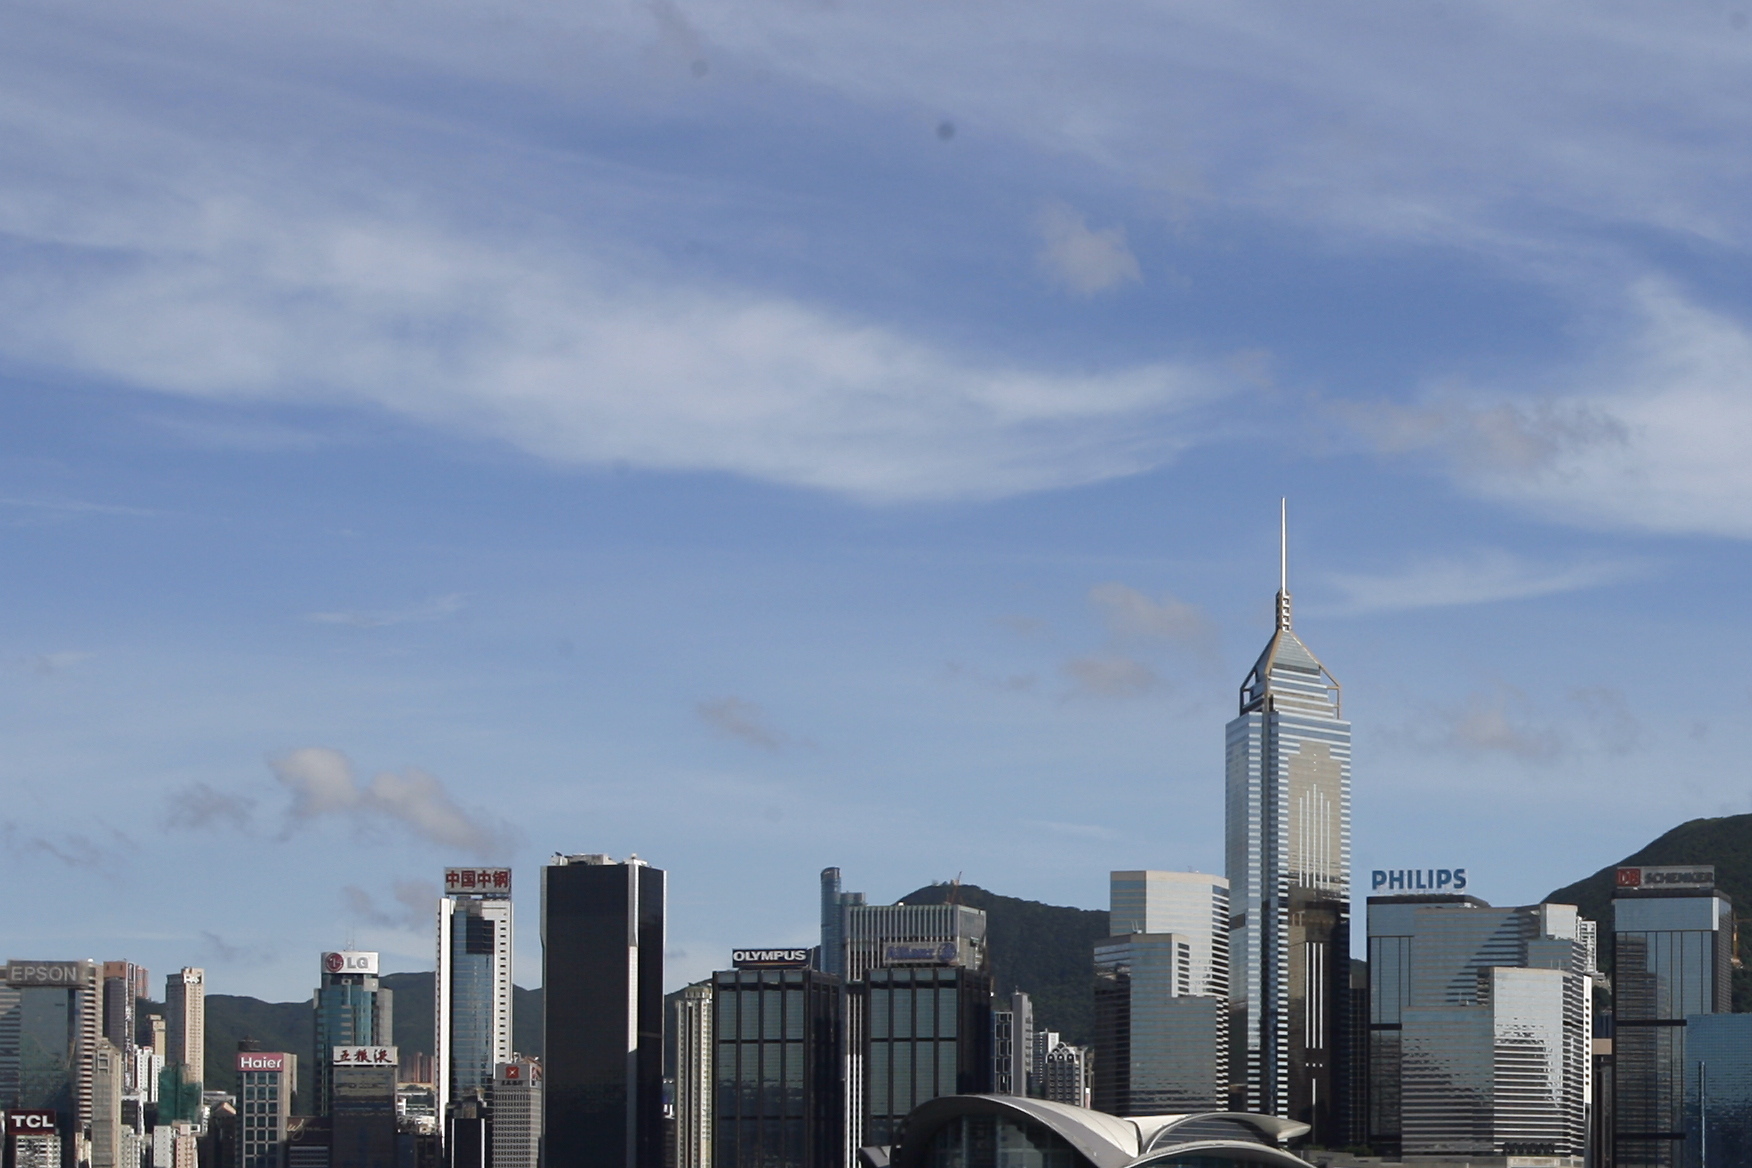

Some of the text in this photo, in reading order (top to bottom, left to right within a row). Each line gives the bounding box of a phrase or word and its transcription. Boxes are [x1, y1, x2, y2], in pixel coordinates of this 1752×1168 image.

[446, 870, 508, 888] 中国中钢
[1372, 869, 1467, 890] PHILIPS
[1645, 872, 1712, 884] SCHENKER
[346, 956, 369, 969] LG
[733, 950, 807, 962] OLYMPUS
[11, 966, 77, 982] EPSON
[240, 1056, 283, 1069] Haier
[11, 1114, 55, 1129] TCL
